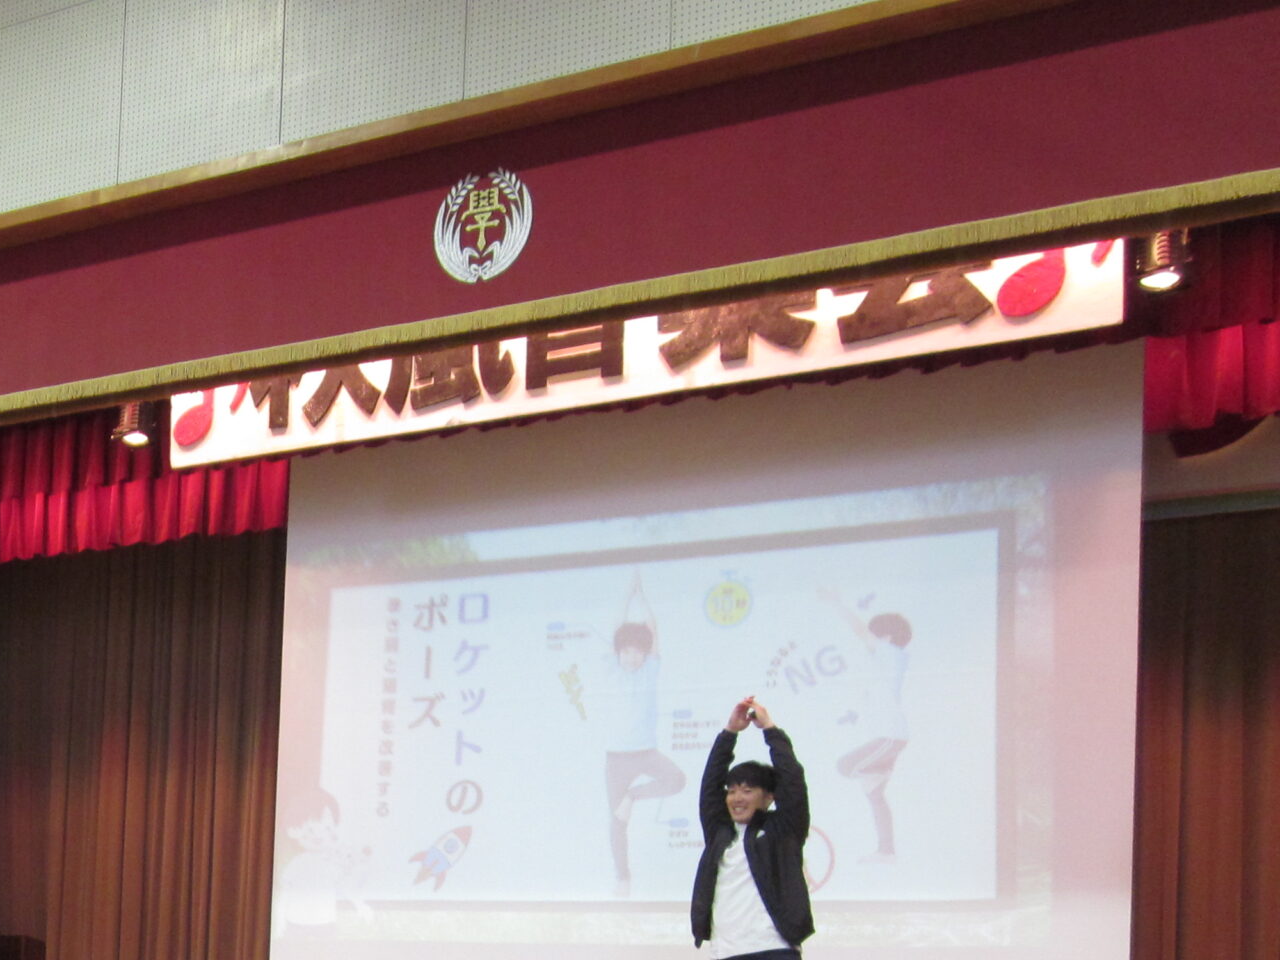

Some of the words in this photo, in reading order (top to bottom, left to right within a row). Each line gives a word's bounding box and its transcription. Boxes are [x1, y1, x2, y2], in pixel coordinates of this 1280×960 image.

[407, 593, 450, 729] ポーズ
[445, 593, 490, 815] ロケットの
[783, 645, 848, 695] NG
